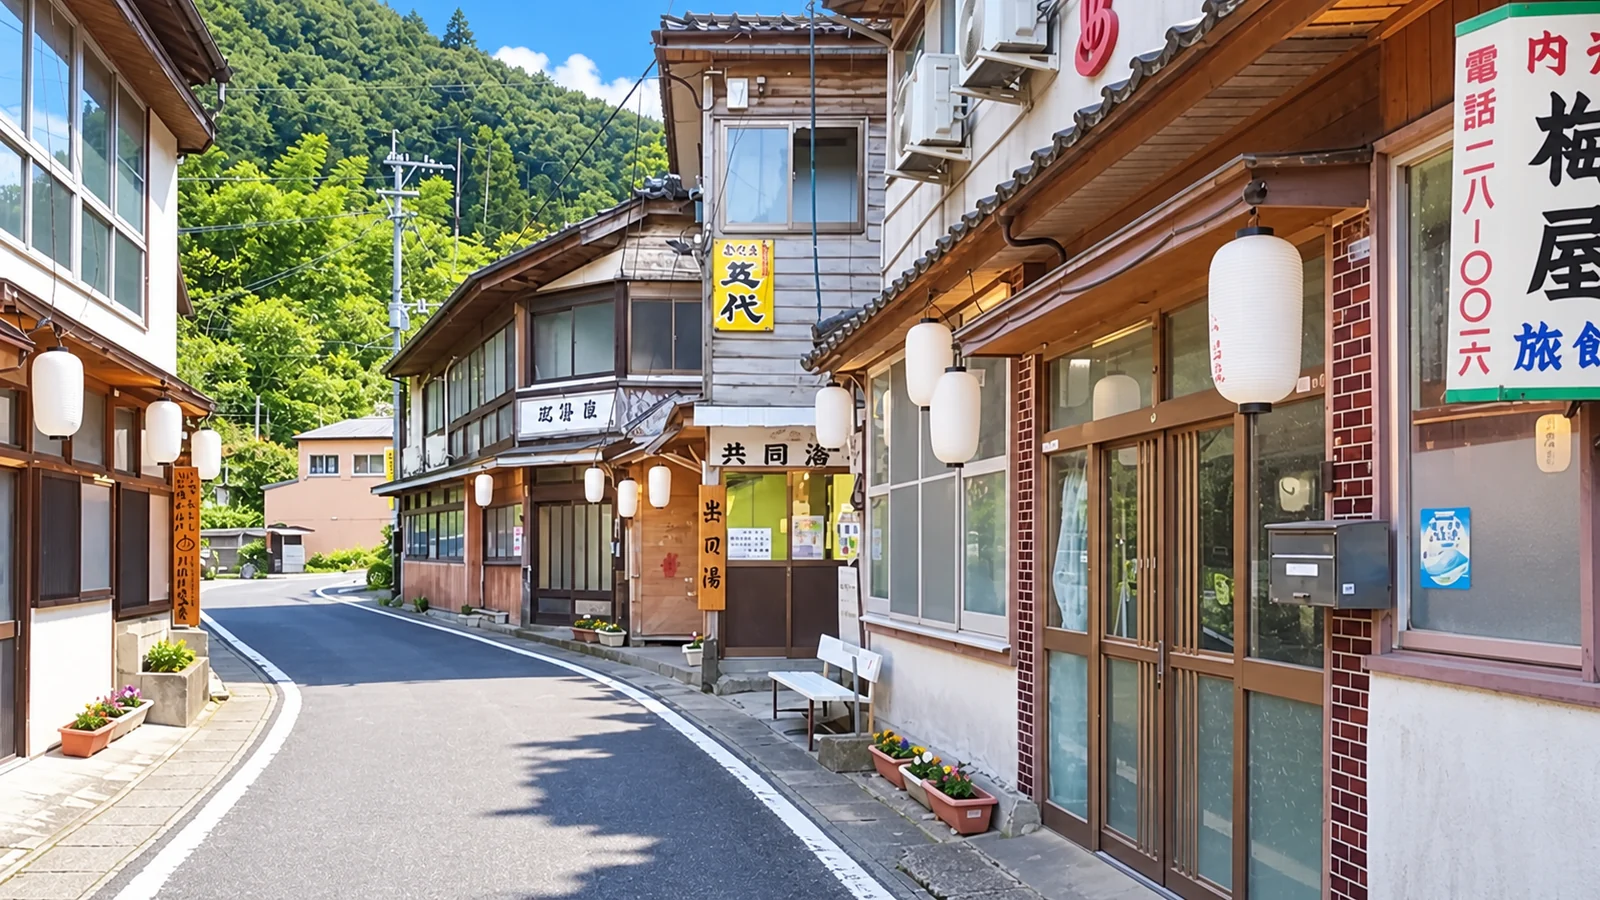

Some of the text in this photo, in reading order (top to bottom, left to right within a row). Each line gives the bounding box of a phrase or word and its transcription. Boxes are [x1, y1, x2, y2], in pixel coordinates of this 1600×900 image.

[1527, 29, 1600, 76] 内
[1527, 91, 1600, 302] 梅屋
[721, 441, 840, 467] 共同浴
